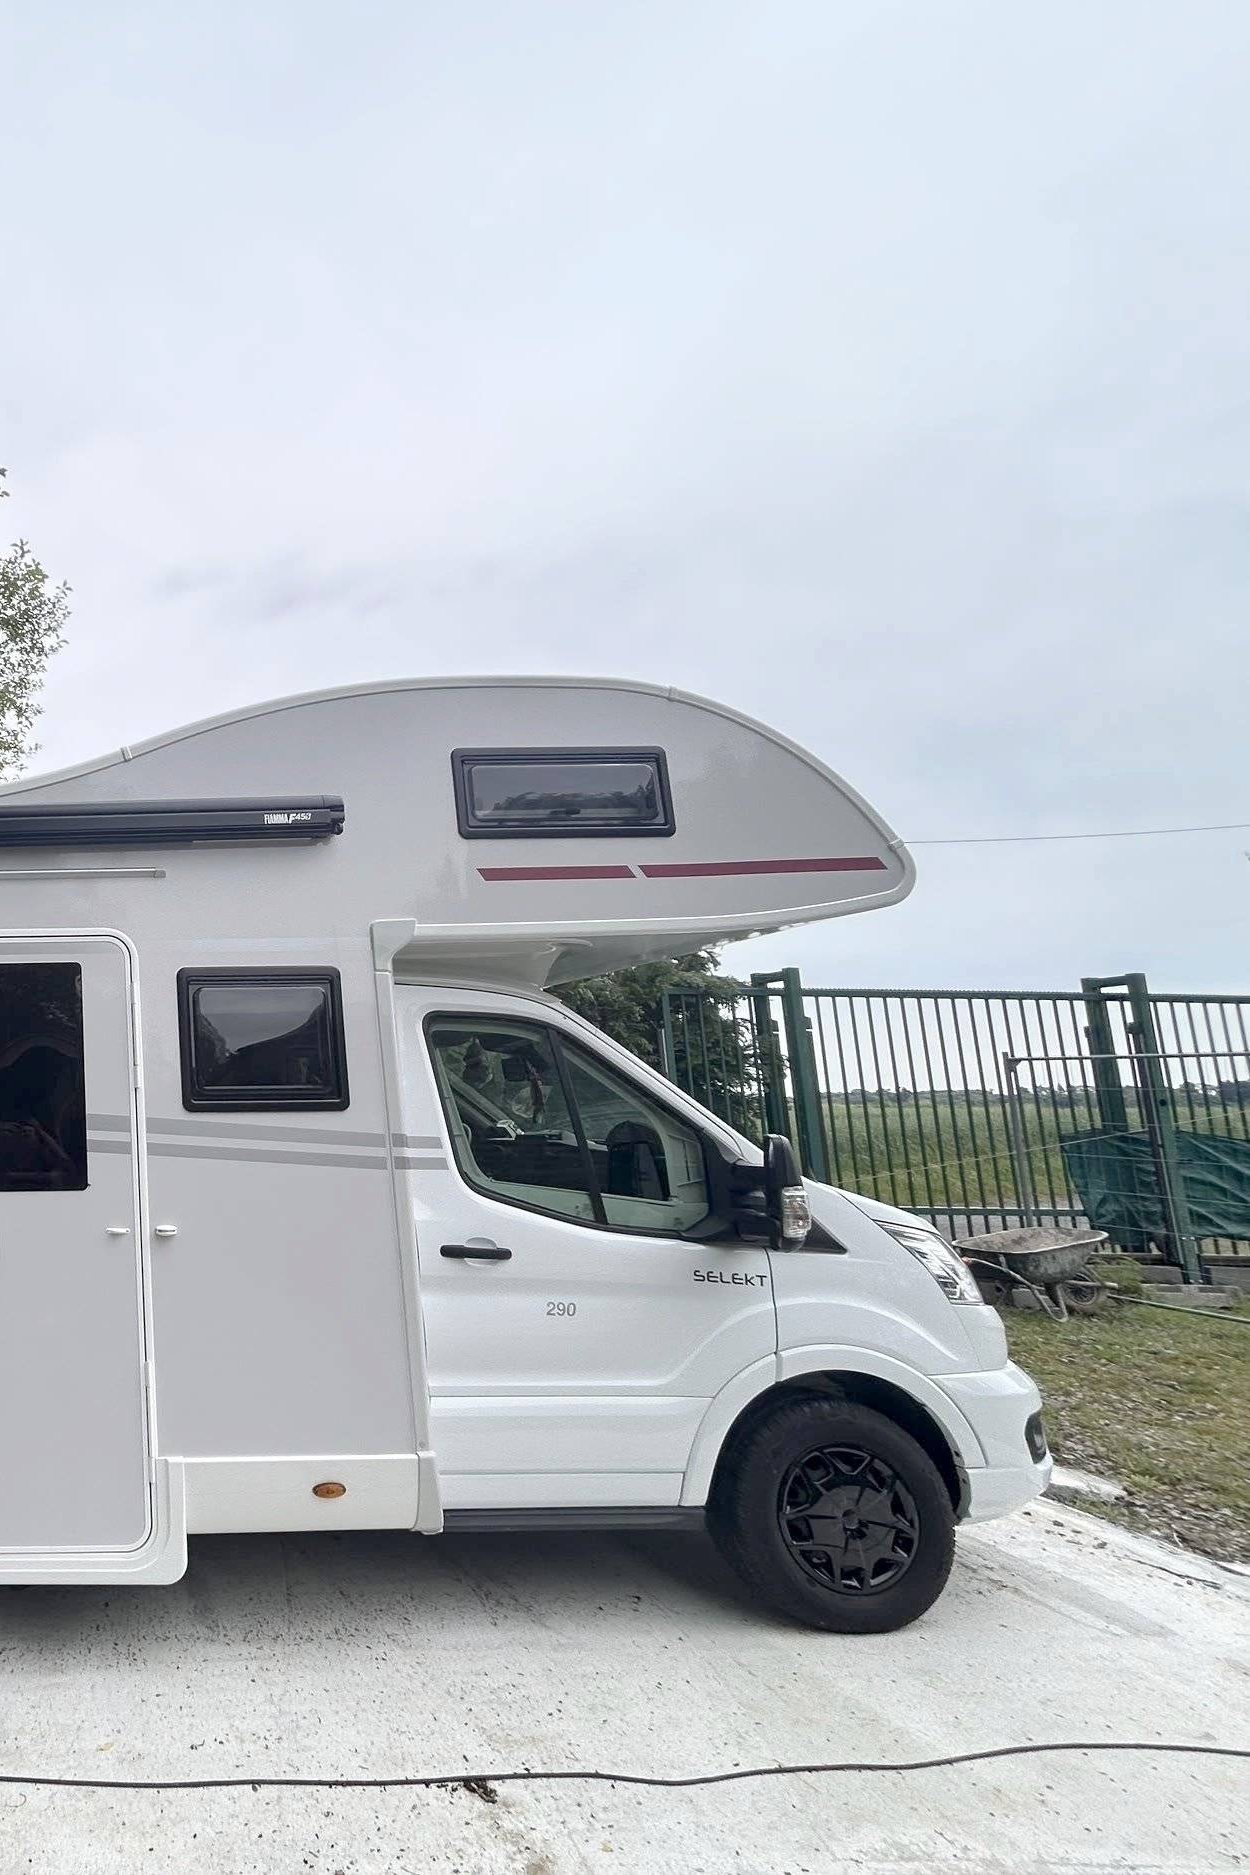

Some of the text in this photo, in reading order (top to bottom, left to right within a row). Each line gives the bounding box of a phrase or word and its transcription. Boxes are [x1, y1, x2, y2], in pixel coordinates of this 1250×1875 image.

[263, 813, 289, 825] FIAMMA
[693, 1269, 768, 1287] SELEKT
[546, 1301, 577, 1317] 290
